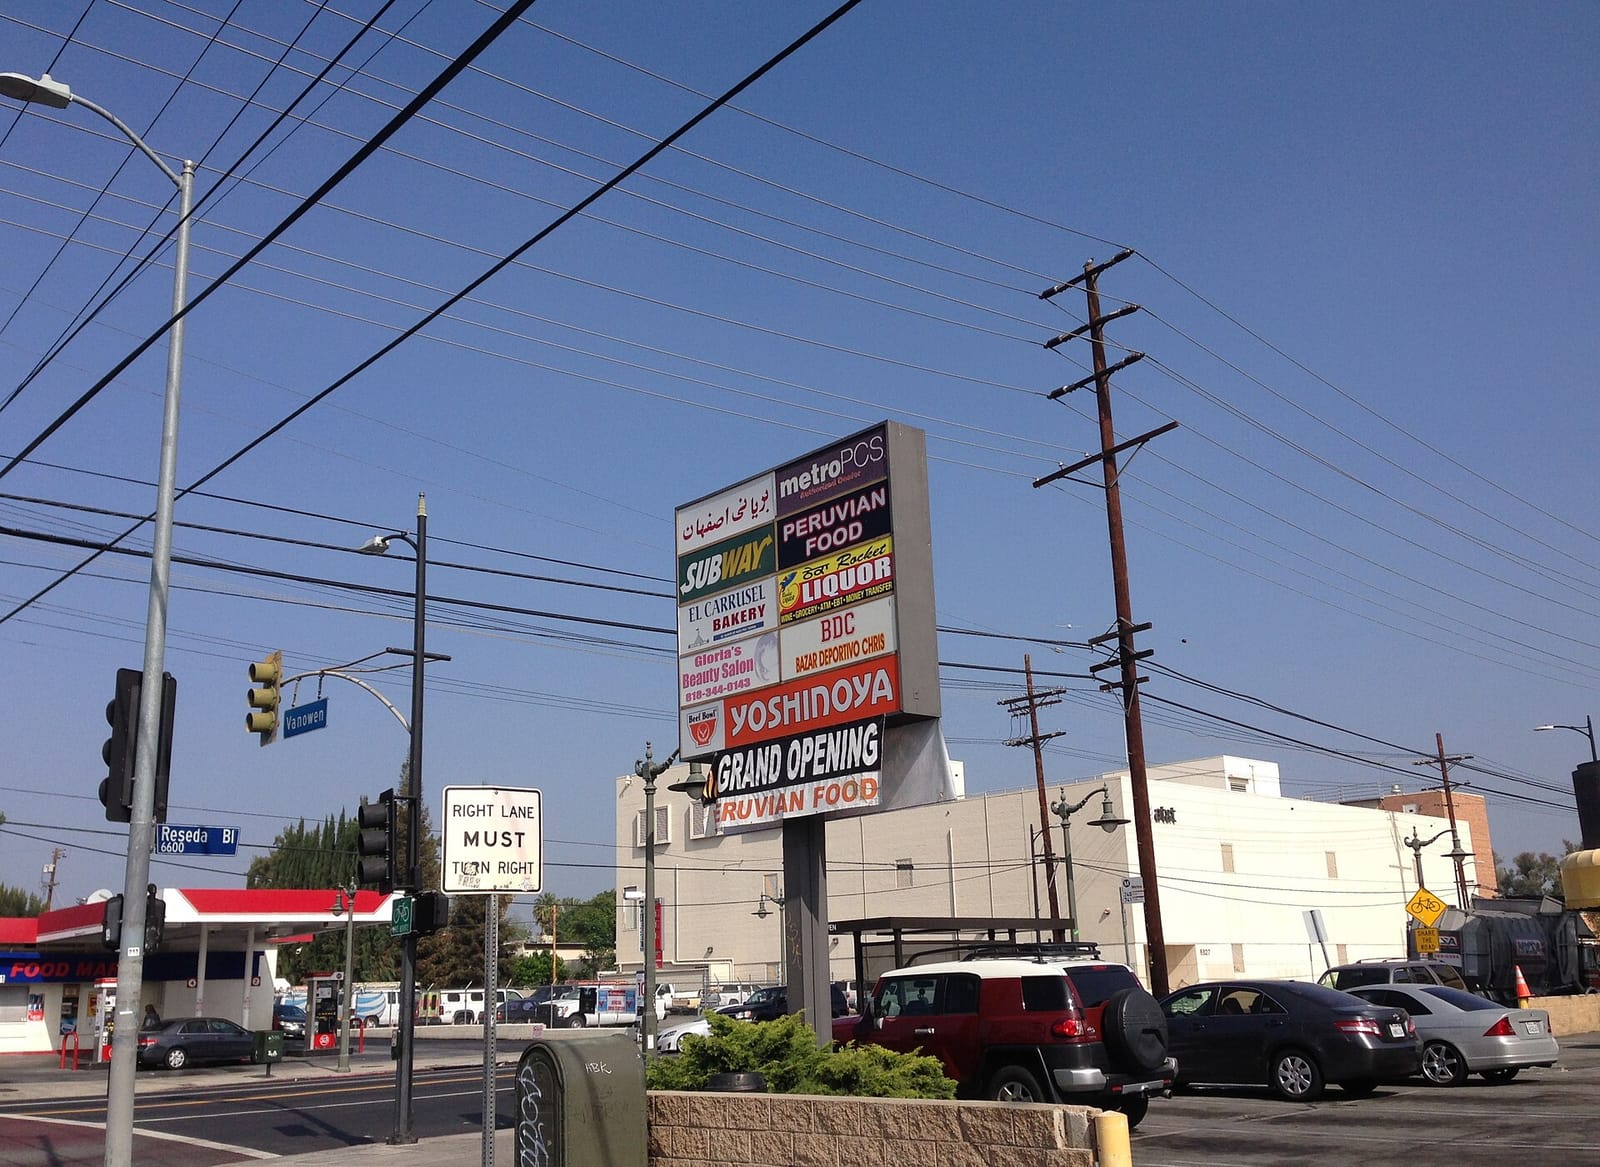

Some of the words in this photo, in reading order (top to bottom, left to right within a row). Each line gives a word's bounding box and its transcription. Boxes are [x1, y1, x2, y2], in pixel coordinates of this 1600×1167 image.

[780, 436, 884, 499] metroPCS
[782, 488, 886, 542] PERUVIAN
[805, 522, 863, 557] FOOD
[680, 534, 773, 596] SUBWAY
[836, 544, 886, 570] Rocket
[802, 556, 892, 603] LIQUOR
[865, 581, 893, 597] TRANSFER
[688, 606, 703, 622] EL
[704, 584, 765, 618] CARRUSEL
[713, 604, 766, 632] BAKERY
[821, 611, 855, 643] BDC
[694, 646, 742, 667] Gloria's
[795, 652, 818, 673] BAZAR
[819, 640, 860, 667] DEPORTIVO
[861, 633, 885, 656] CHRIS
[683, 668, 720, 690] Beauty
[722, 657, 754, 679] Salon
[685, 677, 751, 702] 818-344-0143
[730, 668, 895, 737] YOSHINOYA
[285, 707, 325, 731] Vanowen
[688, 713, 702, 724] Beef
[702, 709, 717, 720] Bowl
[717, 744, 781, 793] GRAND
[786, 722, 879, 782] OPENING
[813, 777, 878, 808] FOOD
[453, 804, 494, 817] RIGHT
[501, 805, 535, 819] LANE
[160, 826, 208, 843] Reseda
[160, 841, 185, 853] 6600
[463, 831, 526, 848] MUST
[498, 861, 535, 875] RIGHT
[10, 961, 71, 978] FOOD
